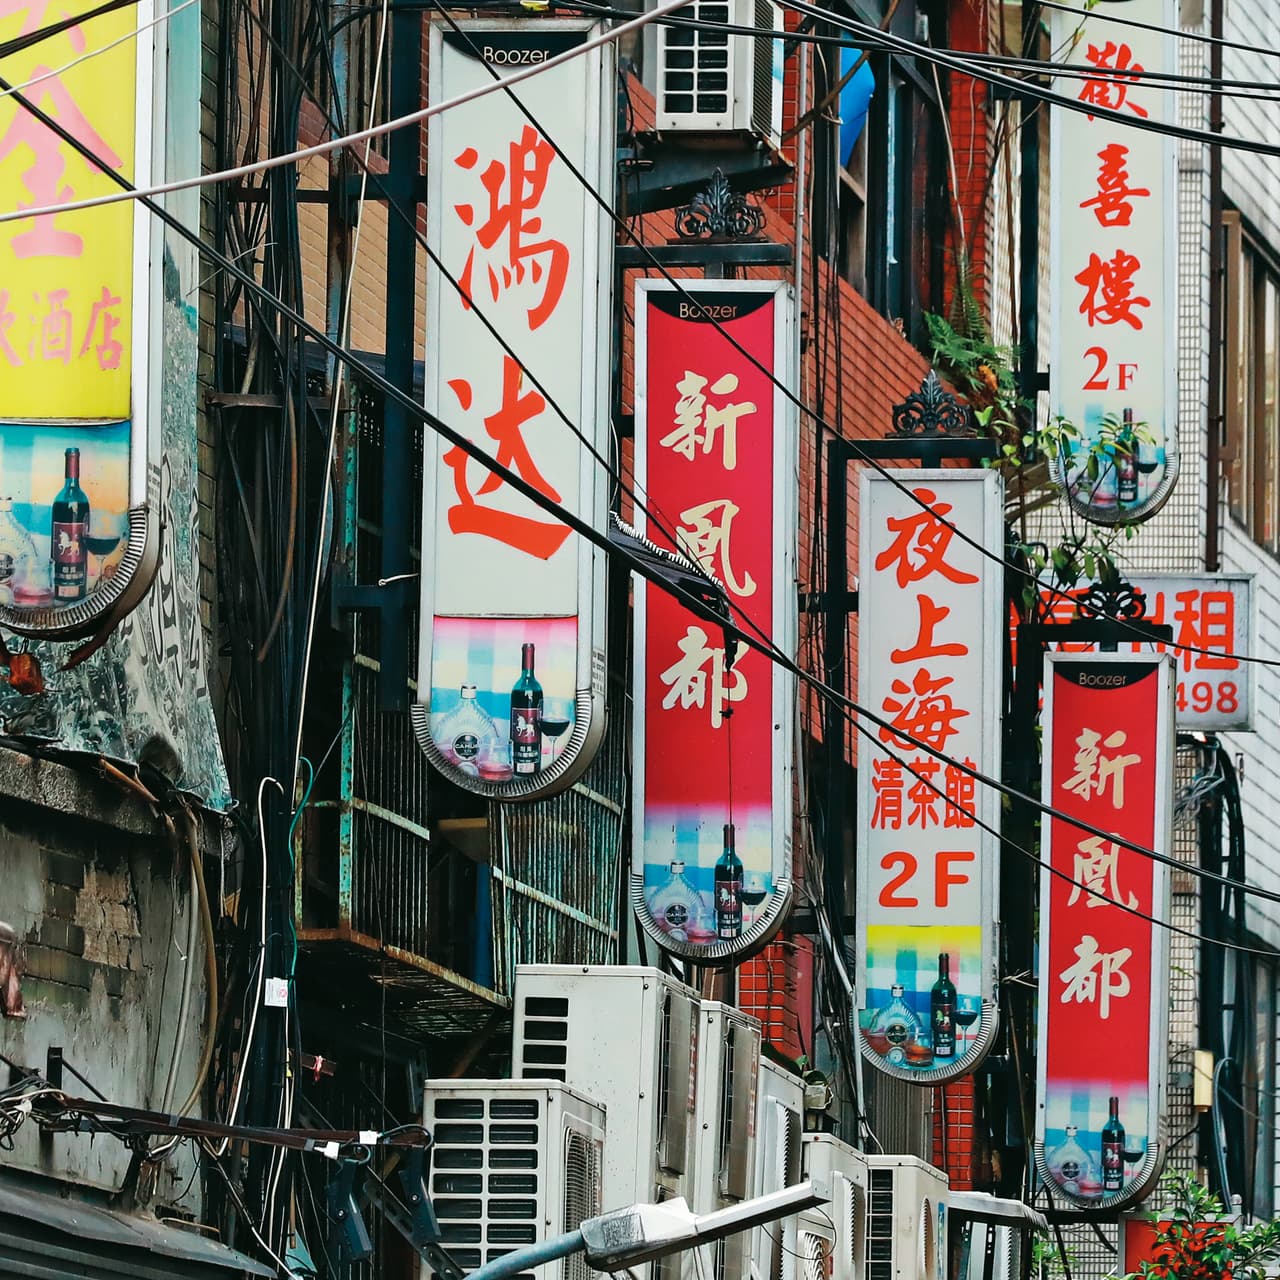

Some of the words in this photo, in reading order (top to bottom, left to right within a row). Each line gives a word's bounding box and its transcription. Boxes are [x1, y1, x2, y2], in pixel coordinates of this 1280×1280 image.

[483, 46, 550, 64] Boozer
[1074, 39, 1152, 331] 歡喜樓
[1081, 345, 1139, 391] 2F
[875, 487, 980, 752] 夜上海
[1079, 672, 1127, 686] Boozer
[870, 755, 977, 831] 清茶館
[878, 850, 976, 909] 2F
